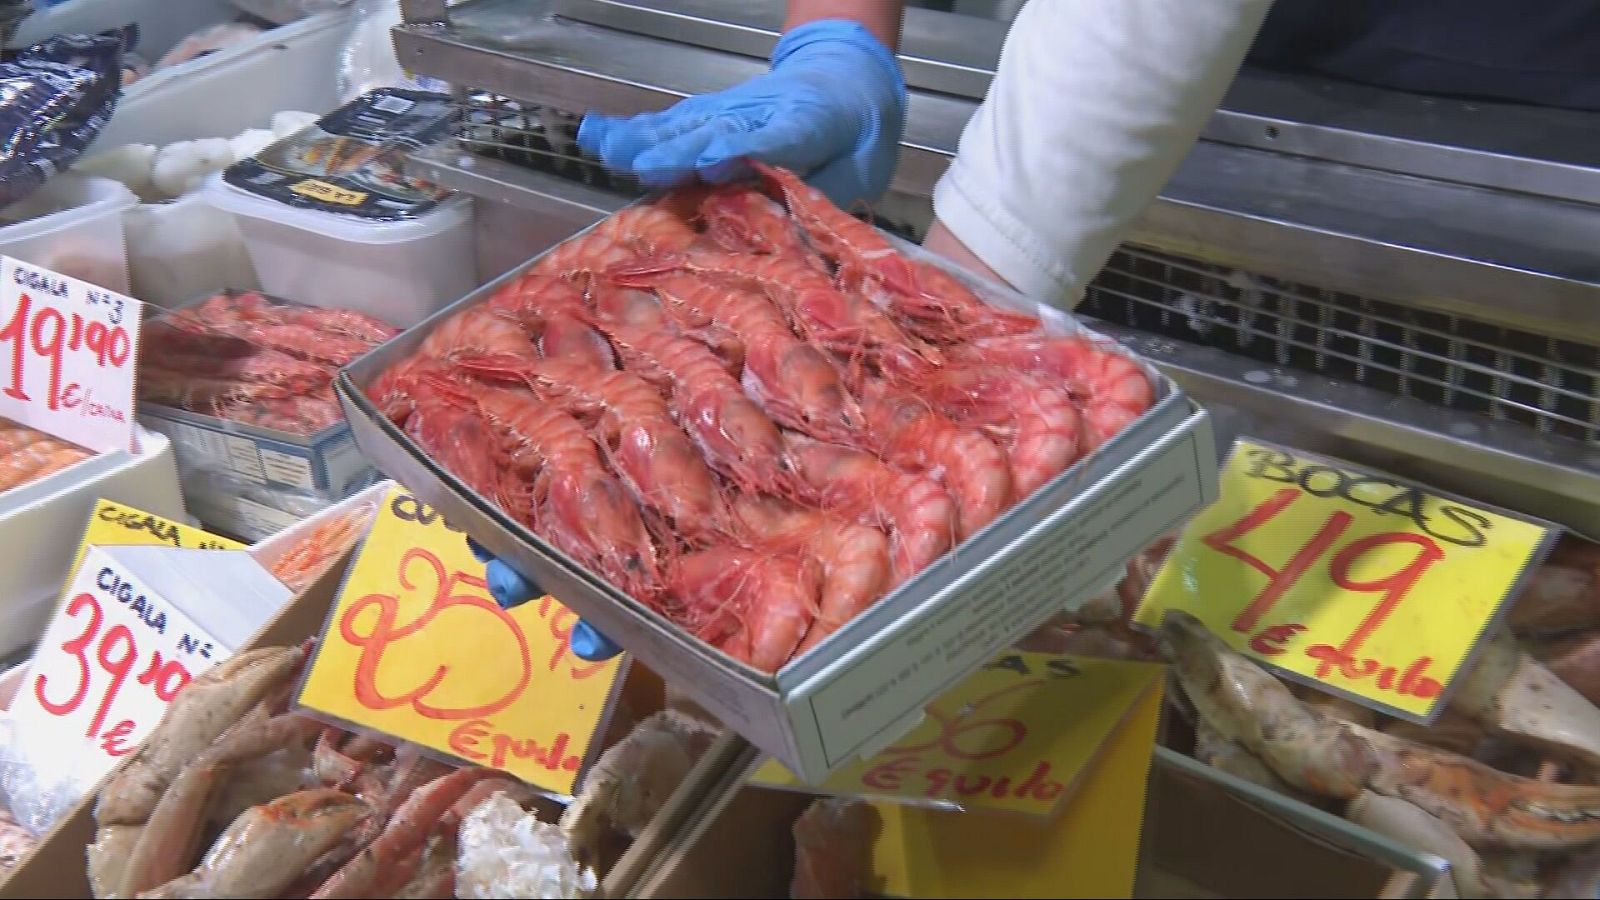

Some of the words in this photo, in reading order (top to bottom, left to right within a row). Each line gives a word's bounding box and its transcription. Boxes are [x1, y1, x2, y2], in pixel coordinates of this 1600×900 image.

[14, 267, 68, 297] CIGALA
[98, 506, 181, 547] CIGALA
[1245, 450, 1492, 547] BOCAS
[97, 566, 168, 635] CIGALA
[1202, 488, 1446, 655] 49
